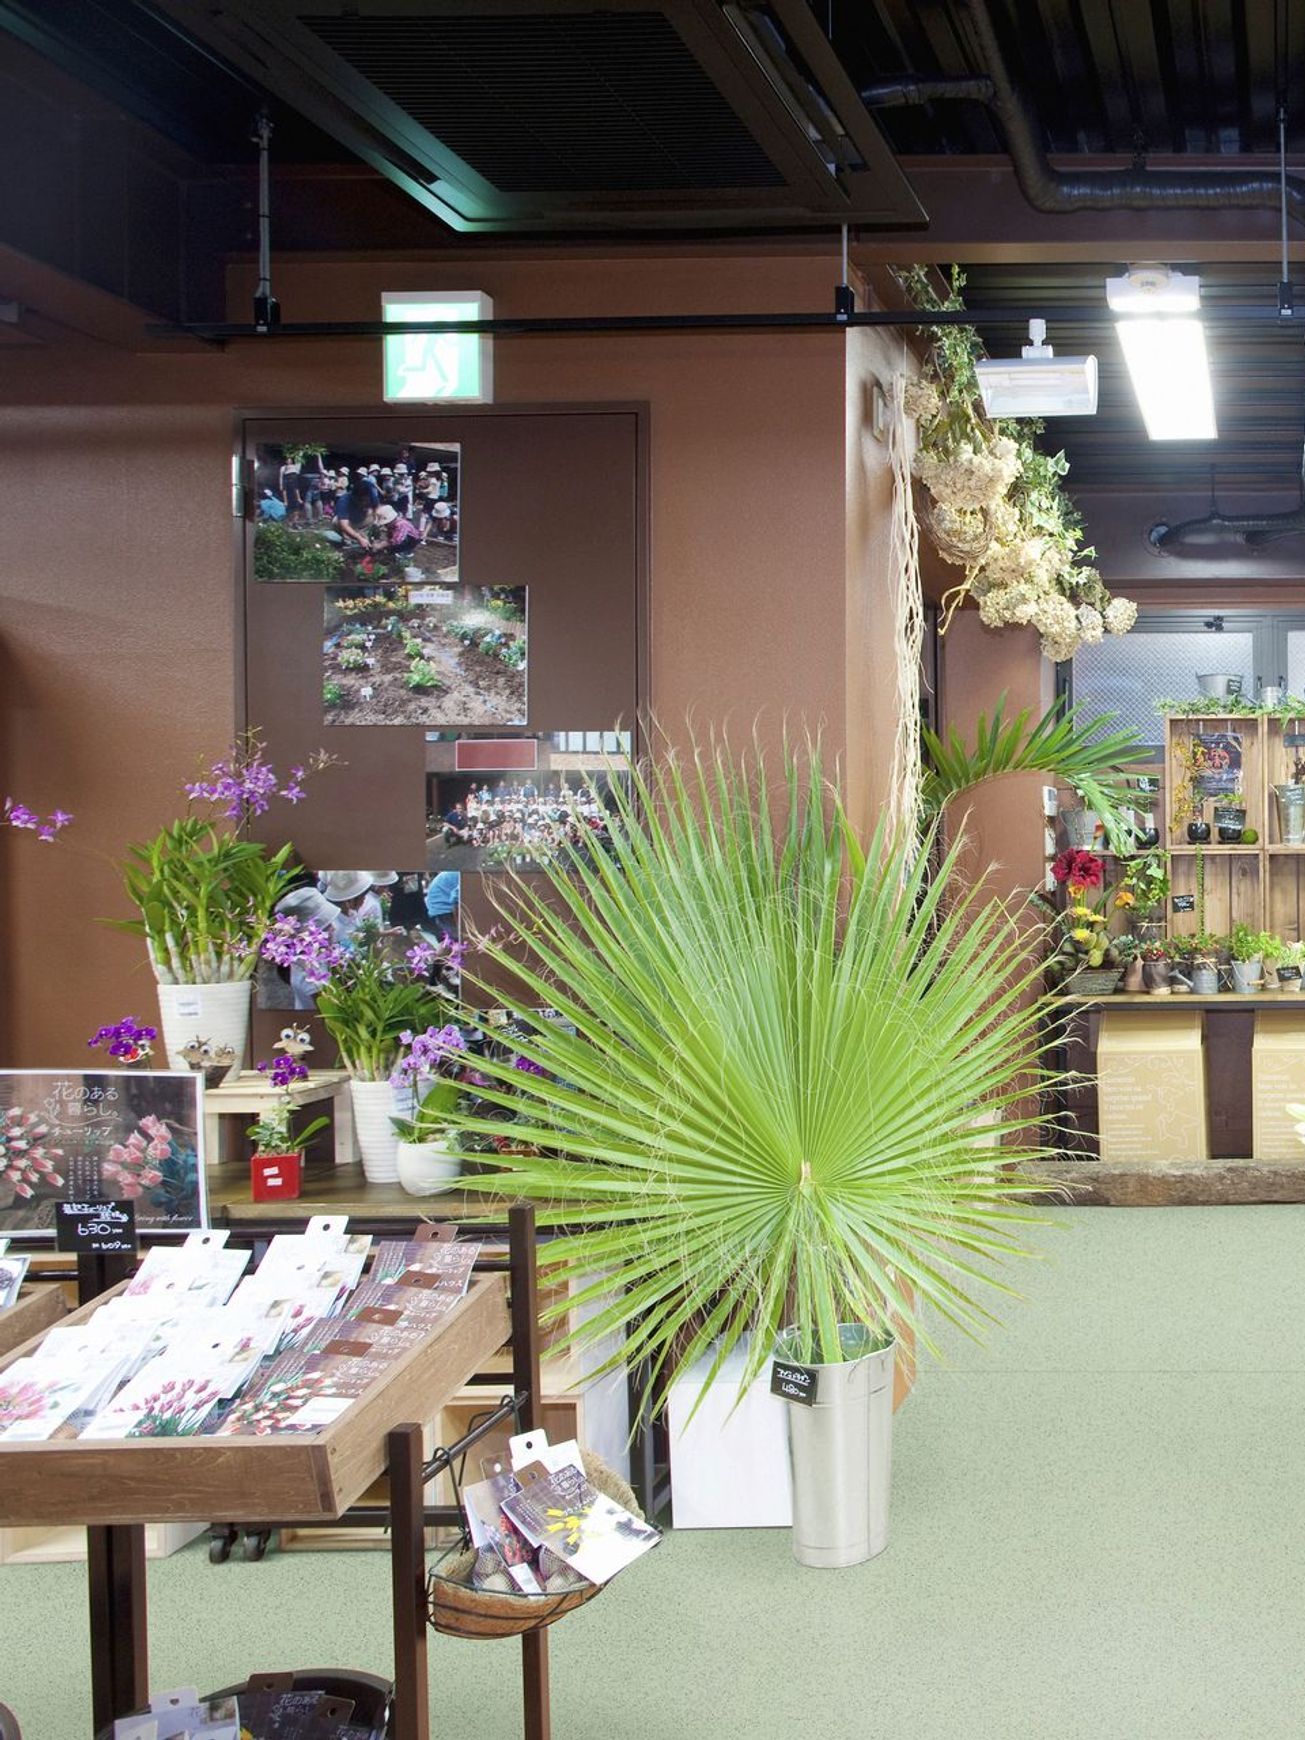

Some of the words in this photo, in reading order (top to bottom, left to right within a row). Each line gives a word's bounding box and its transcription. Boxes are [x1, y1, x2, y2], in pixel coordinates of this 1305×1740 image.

[53, 1081, 119, 1100] 花のある
[78, 1222, 111, 1237] 630
